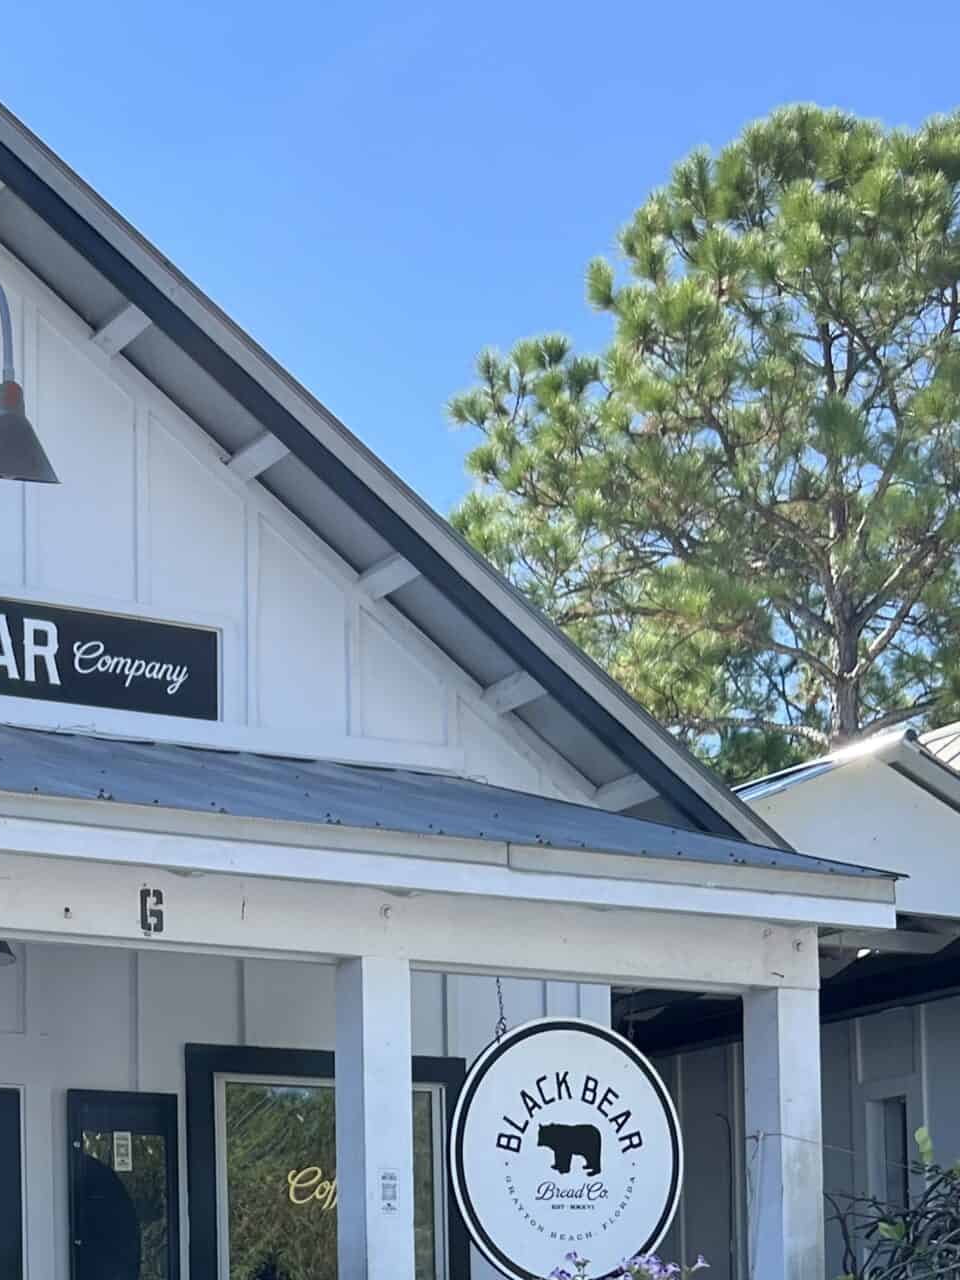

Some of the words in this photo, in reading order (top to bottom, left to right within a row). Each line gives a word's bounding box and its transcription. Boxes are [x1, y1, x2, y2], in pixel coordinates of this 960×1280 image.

[73, 640, 190, 694] Company
[496, 1071, 572, 1153] BLACK
[581, 1075, 643, 1153] BEAR
[535, 1181, 587, 1200] Bread
